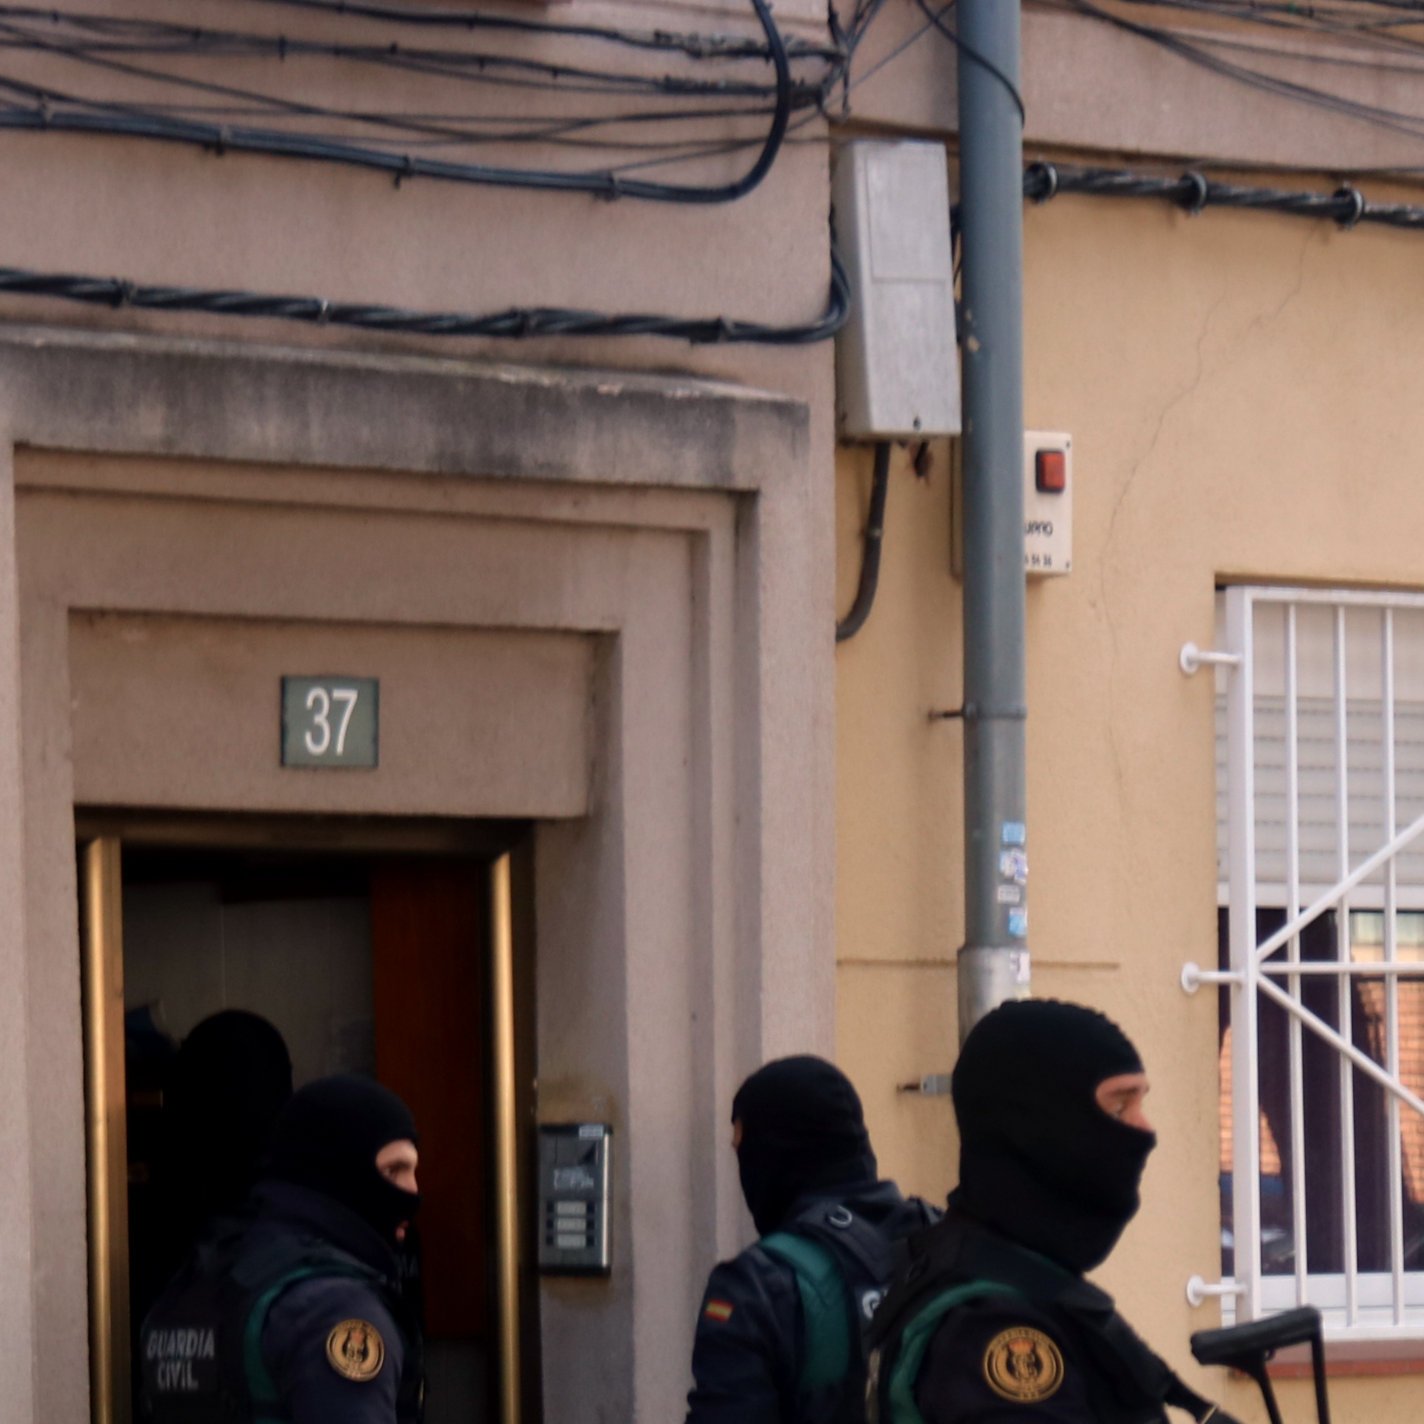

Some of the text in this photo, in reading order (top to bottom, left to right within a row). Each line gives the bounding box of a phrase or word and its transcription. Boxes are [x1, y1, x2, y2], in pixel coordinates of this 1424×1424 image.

[304, 687, 358, 756] 37
[147, 1327, 215, 1360] GUARDIA
[157, 1359, 199, 1392] CIVIL
